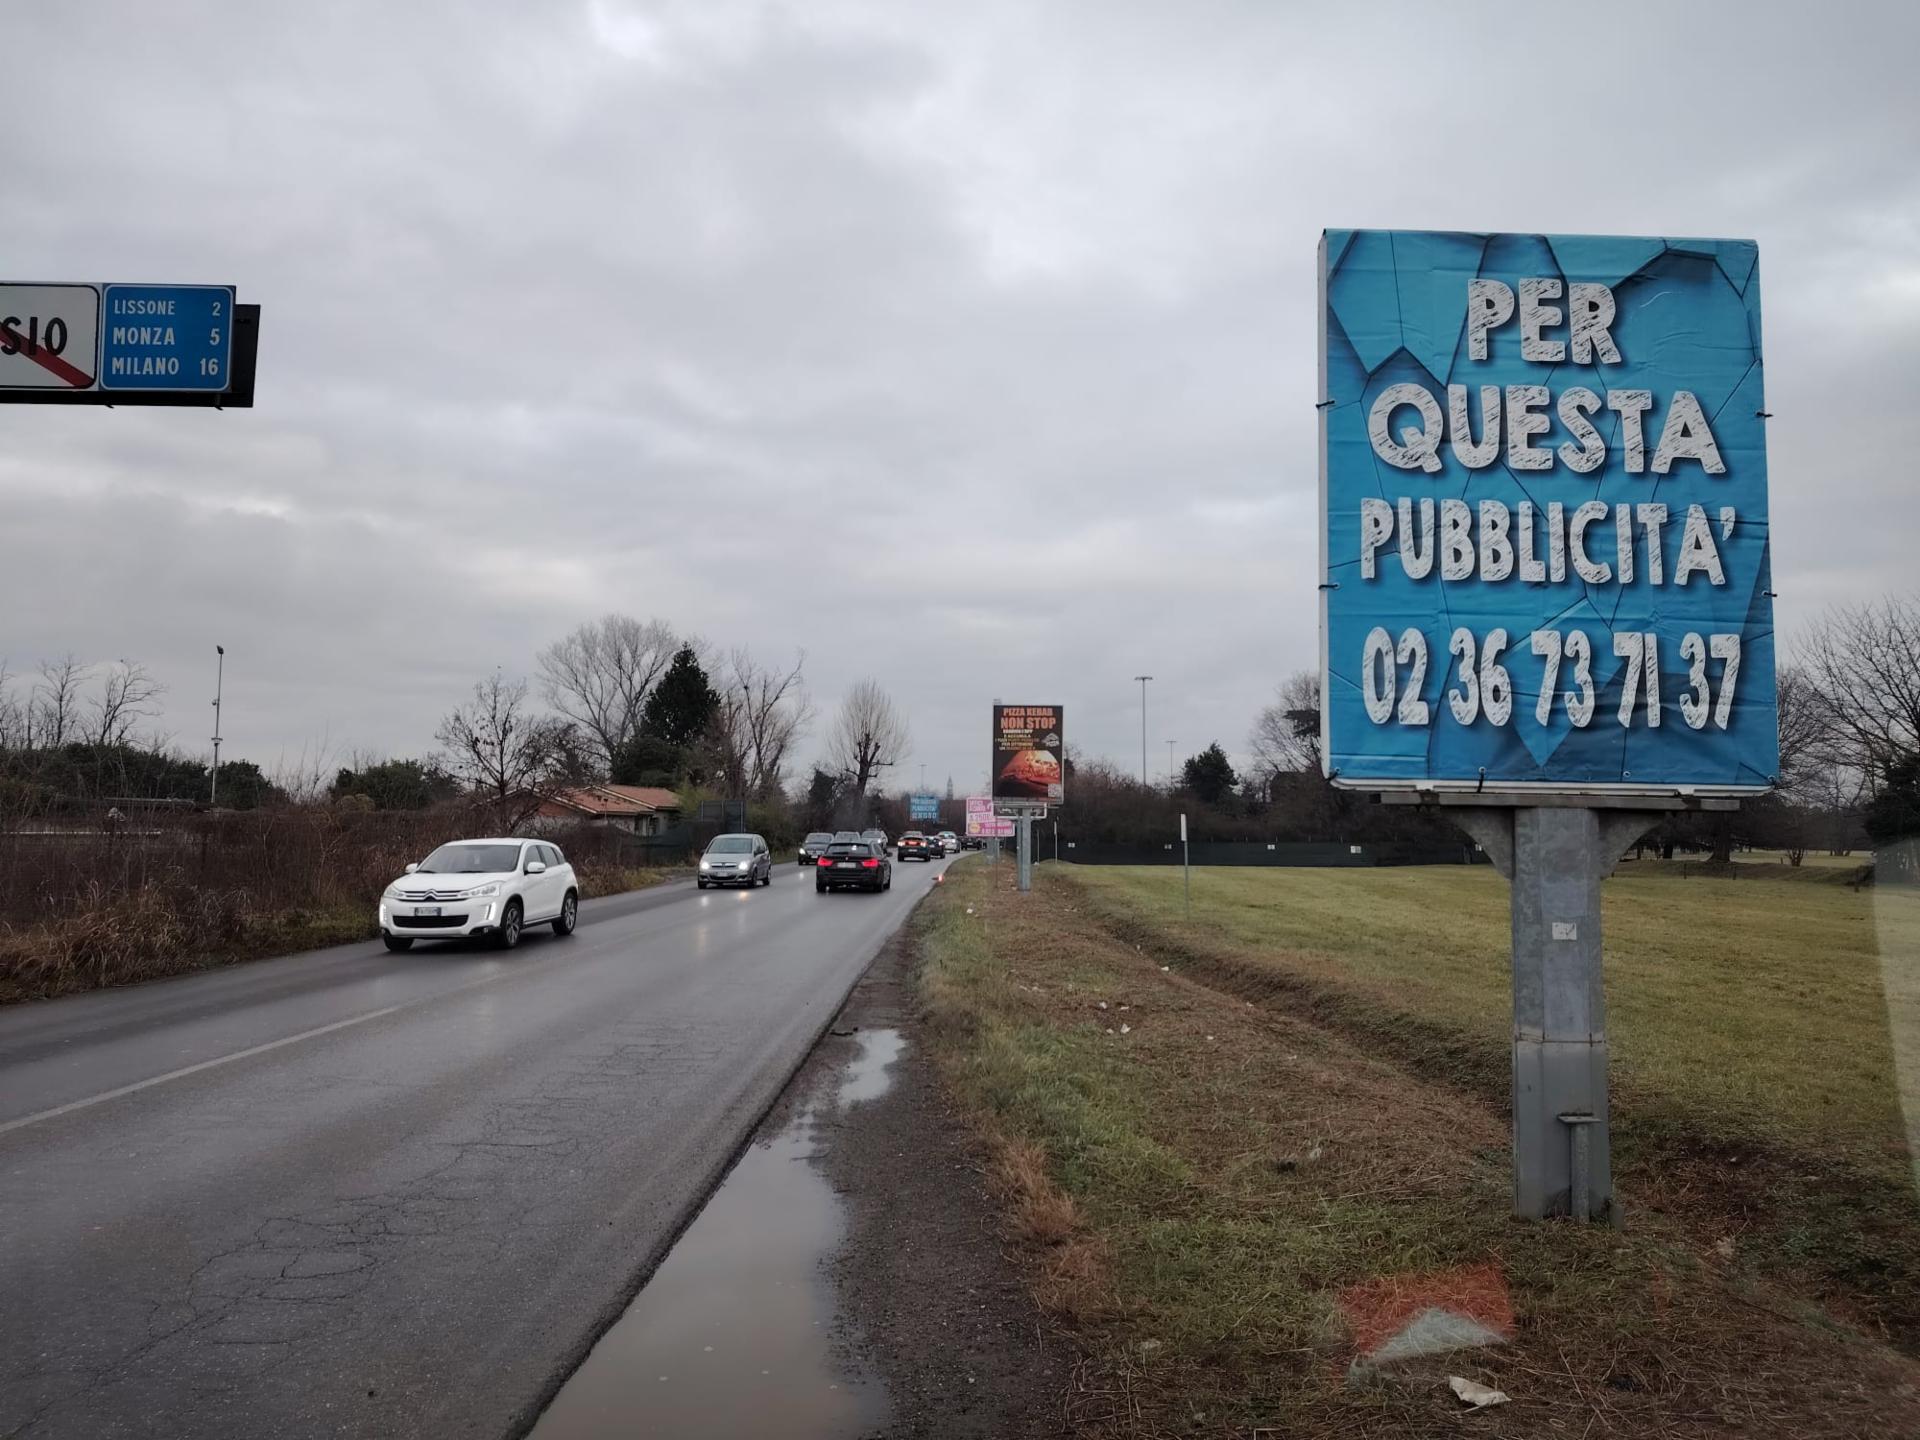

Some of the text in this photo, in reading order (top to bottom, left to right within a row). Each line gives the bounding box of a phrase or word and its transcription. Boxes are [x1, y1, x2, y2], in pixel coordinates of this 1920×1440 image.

[113, 299, 221, 316] LISSONE 2
[1467, 277, 1622, 365] PER
[0, 315, 68, 356] SIO
[112, 327, 220, 346] MONZA 5
[111, 357, 219, 376] MILANO 16
[1367, 382, 1727, 474] QUESTA
[1360, 497, 1736, 586] PUBBLICITA'
[1362, 626, 1742, 731] 02 36 73 71 37
[1001, 717, 1056, 730] NON STOP
[1003, 707, 1053, 717] PIZZA KEBAB
